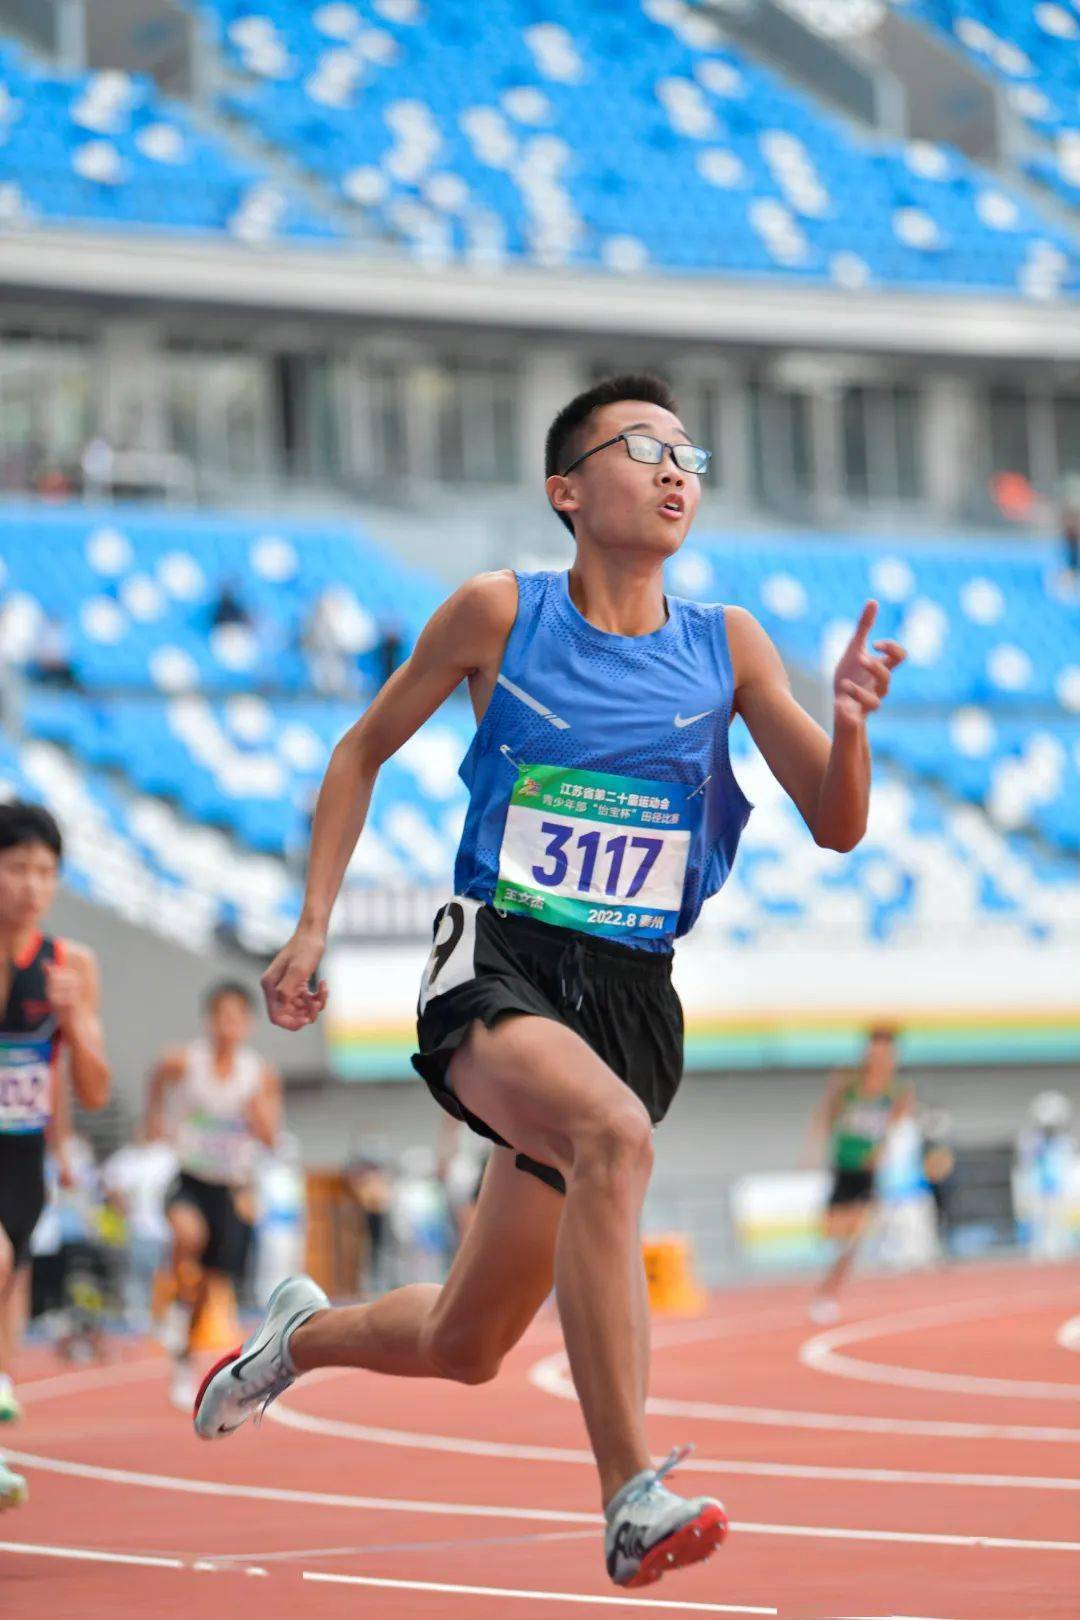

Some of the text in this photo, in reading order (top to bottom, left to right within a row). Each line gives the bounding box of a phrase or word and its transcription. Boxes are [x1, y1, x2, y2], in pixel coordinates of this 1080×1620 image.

[560, 783, 670, 810] 江苏省第二十届运动会
[532, 822, 664, 898] 3117
[587, 909, 636, 927] 2022.8
